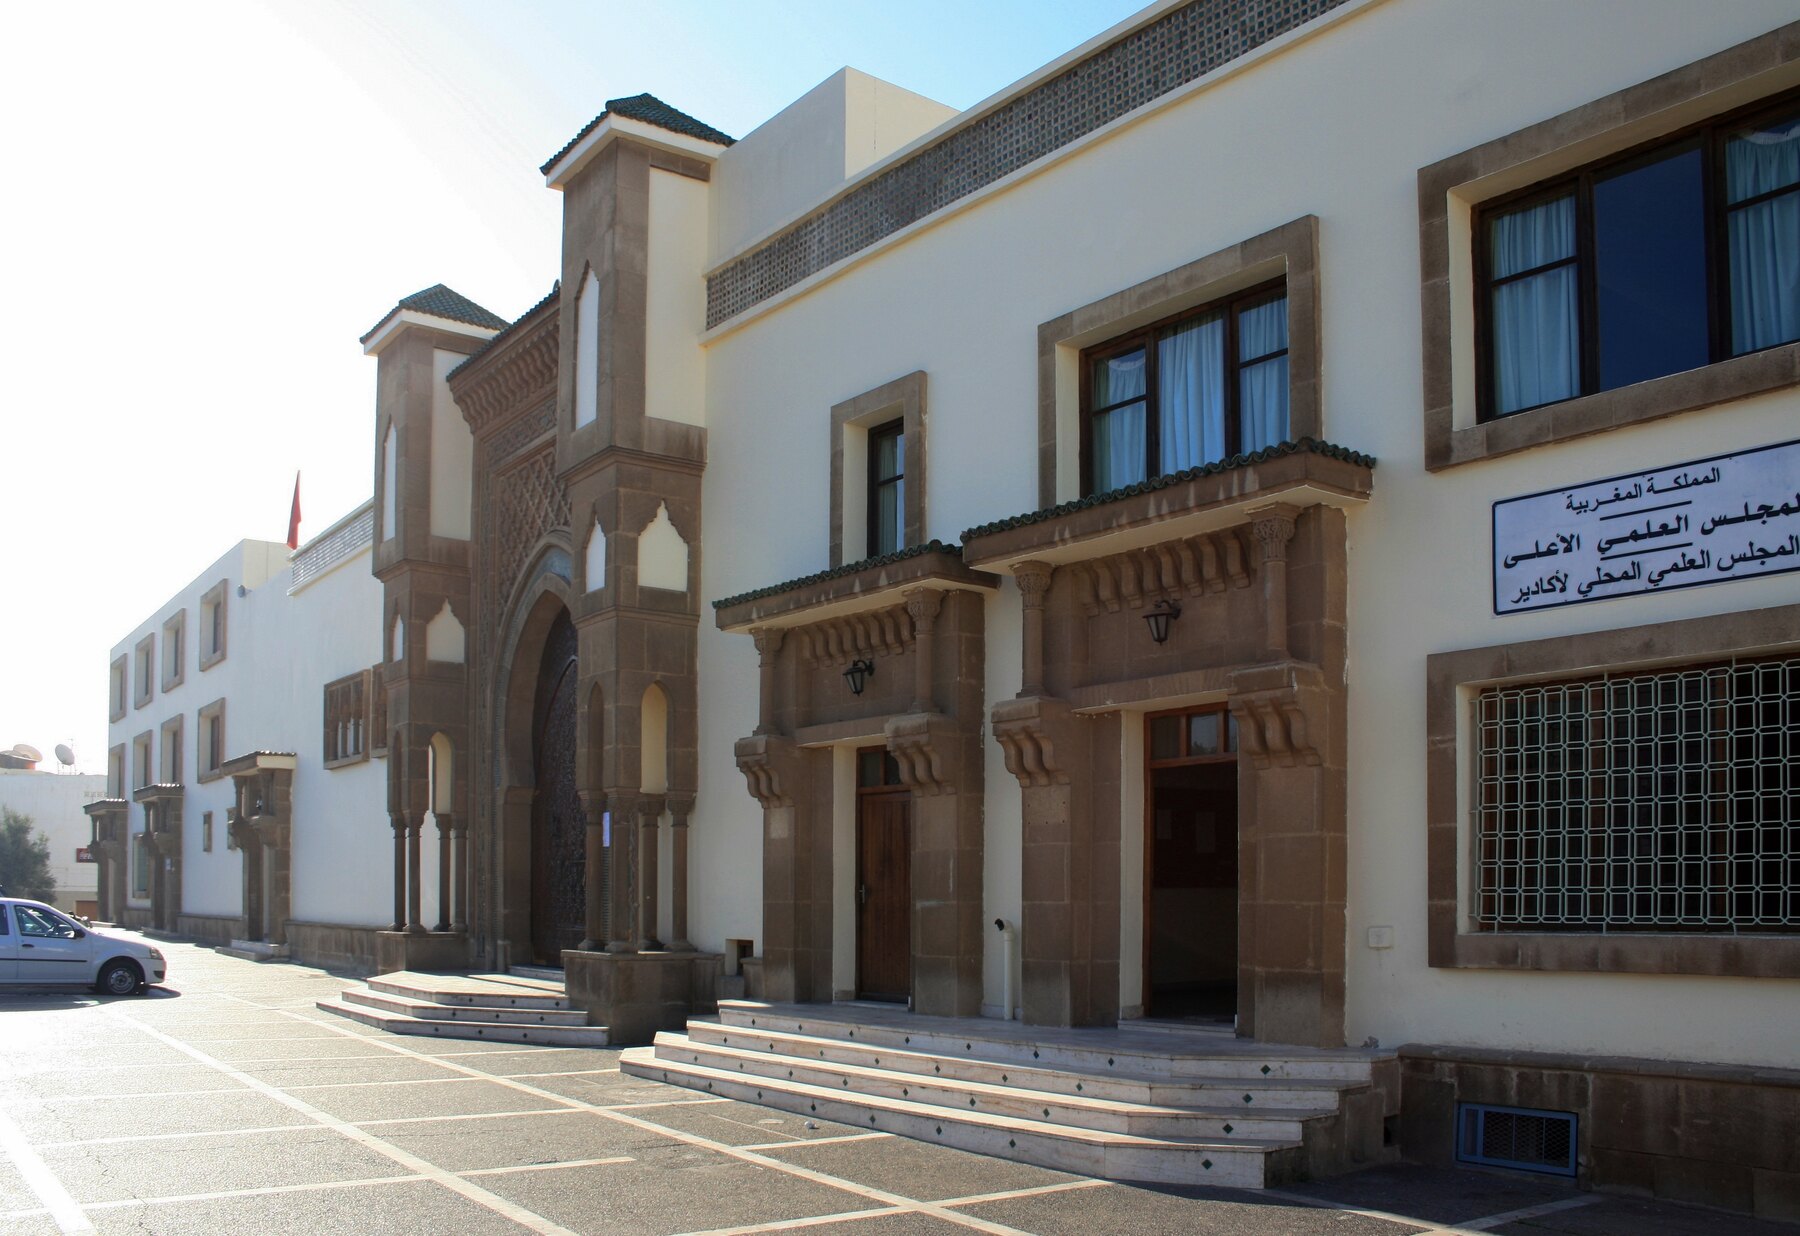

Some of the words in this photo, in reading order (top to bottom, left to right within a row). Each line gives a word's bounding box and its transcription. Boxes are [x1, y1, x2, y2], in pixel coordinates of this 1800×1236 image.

[1701, 492, 1800, 535] لمجلس
[1503, 533, 1581, 569] الأعلى
[1597, 514, 1689, 553] العلمي
[1717, 534, 1800, 572] المجلس
[1510, 570, 1569, 604] لأكادير
[1577, 560, 1642, 599] المحلي
[1648, 549, 1711, 588] العلمي
